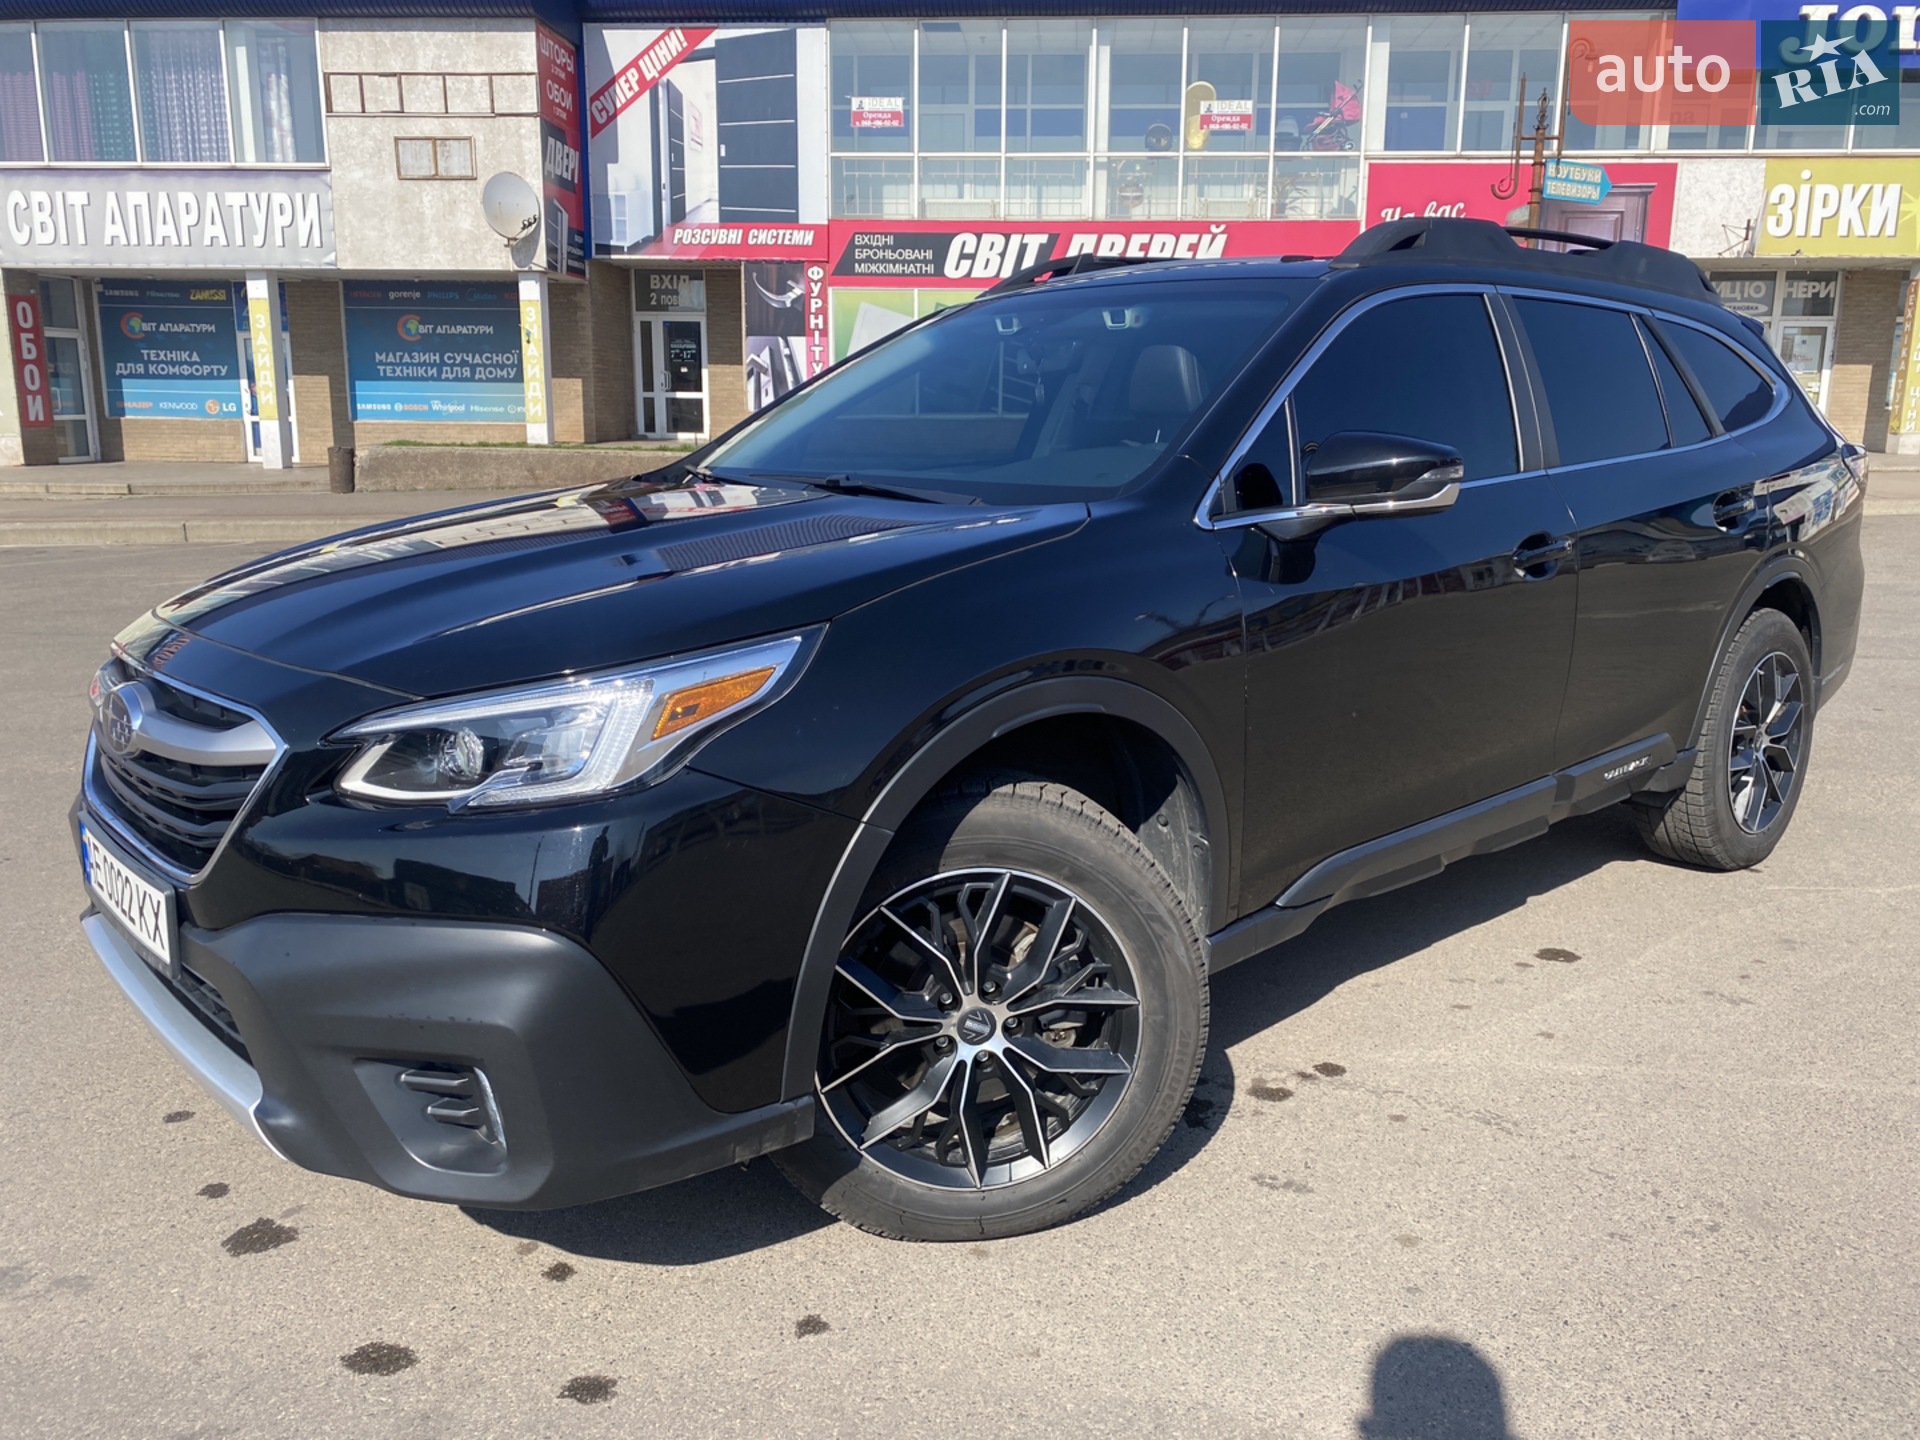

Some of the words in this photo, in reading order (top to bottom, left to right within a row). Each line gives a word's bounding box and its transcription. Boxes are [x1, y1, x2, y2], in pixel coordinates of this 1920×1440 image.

[539, 32, 575, 74] ШТОРЫ
[590, 72, 640, 125] СУПЕР
[638, 27, 689, 82] ЦІНИ!
[546, 79, 573, 112] ОБОИ
[545, 136, 580, 184] ДВЕРІ
[1548, 162, 1602, 183] НОУТБУКИ
[1546, 181, 1600, 200] ТЕЛЕВИЗОРЫ
[1767, 169, 1902, 238] ЗІРКИ
[6, 189, 91, 246] СВІТ
[103, 190, 324, 248] АПАРАТУРИ
[673, 228, 743, 245] РОЗСУВНІ
[747, 229, 815, 246] СИСТЕМИ
[854, 234, 894, 247] ВХІДНІ
[854, 248, 933, 260] БРОНЬОВАНІ
[943, 232, 1049, 278] СВІТ
[1064, 224, 1229, 260] ДВЕРЕЙ
[854, 262, 935, 274] МІЖКІМНАТНІ
[650, 274, 690, 291] ВХІД
[1783, 281, 1837, 299] НЕРИ
[104, 289, 139, 297] SAMSUNG
[189, 288, 227, 300] ZANUSSI
[388, 290, 421, 300] gorenje
[427, 291, 459, 300] PHILIPS
[650, 291, 657, 305] 2
[158, 322, 216, 333] АПАРАТУРИ
[436, 324, 493, 335] АПАРАТУРИ
[1899, 281, 1917, 371] ТЕХНІКА
[16, 301, 45, 422] ОБОИ
[140, 350, 200, 362] ТЕХНІКА
[255, 314, 274, 406] ЗАЙДИ
[375, 351, 440, 364] МАГАЗИН
[443, 350, 519, 365] СУЧАСНОЇ
[115, 363, 145, 376] ДЛЯ
[148, 363, 228, 376] КОМФОРТУ
[377, 366, 438, 378] ТЕХНІКИ
[441, 366, 471, 380] ДЛЯ
[474, 367, 517, 381] ДОМУ
[1894, 379, 1904, 415] ТУТ
[116, 401, 153, 409] SHARP
[159, 402, 198, 410] KENWOOD
[222, 402, 237, 412] LG
[356, 403, 391, 411] SAMSUNG
[430, 400, 465, 413] Whirlpool
[470, 405, 505, 413] Hisense
[103, 854, 136, 926] 0022
[135, 883, 166, 952] KX
